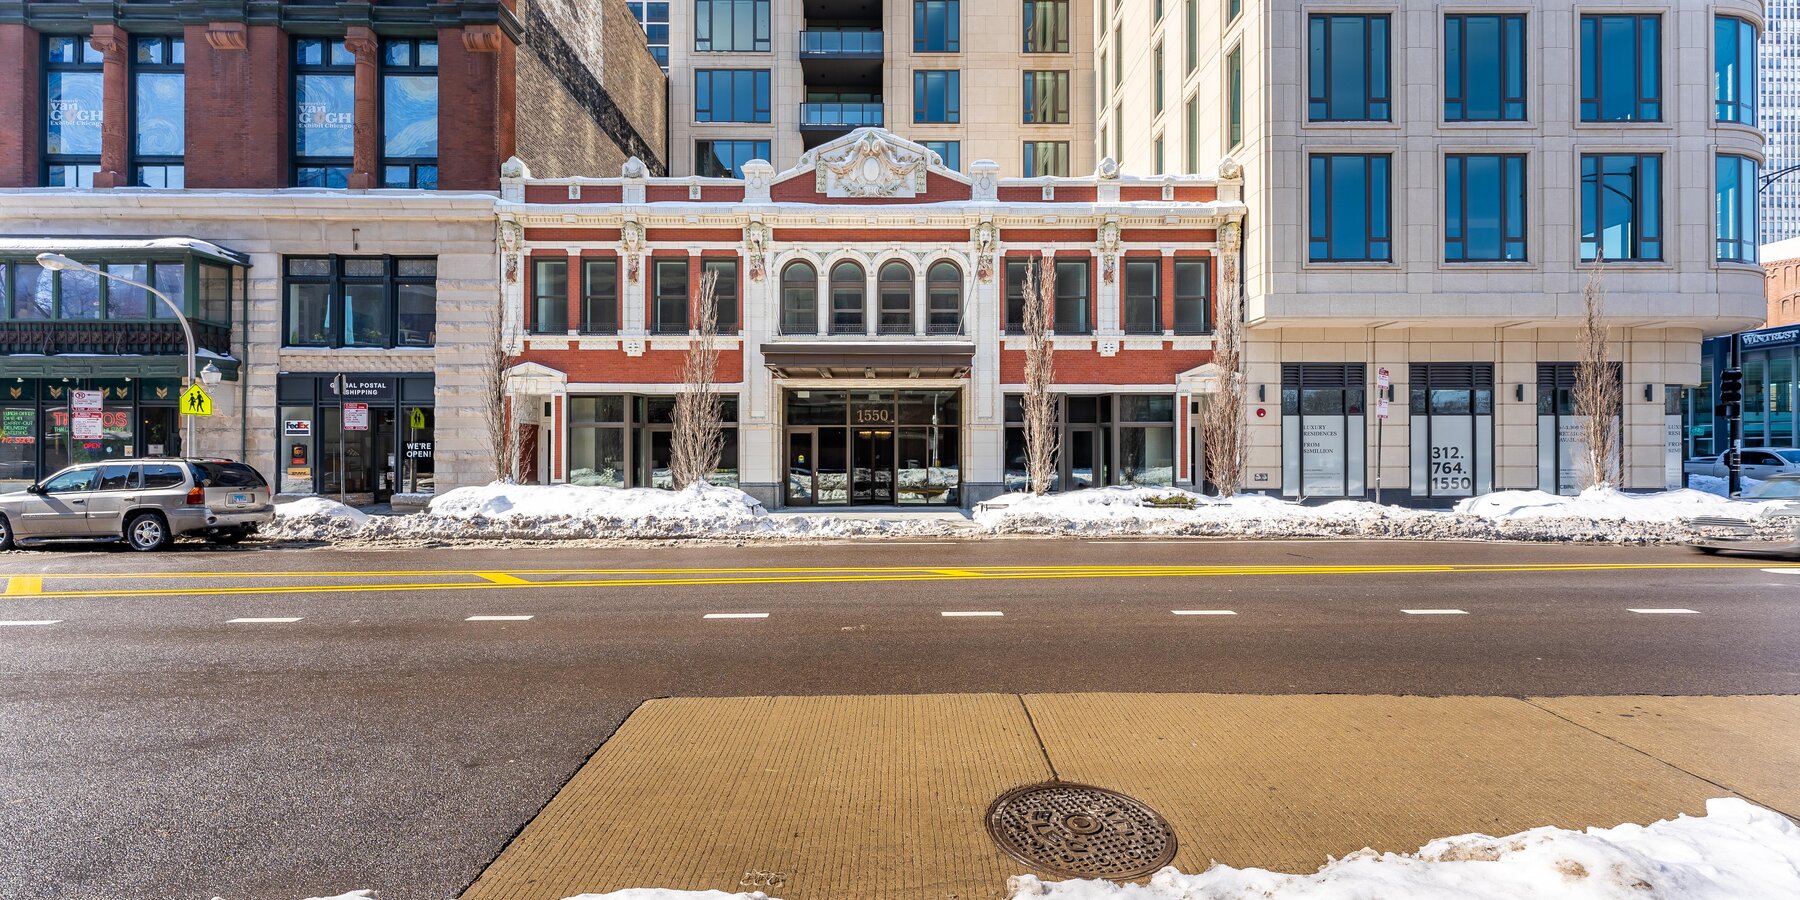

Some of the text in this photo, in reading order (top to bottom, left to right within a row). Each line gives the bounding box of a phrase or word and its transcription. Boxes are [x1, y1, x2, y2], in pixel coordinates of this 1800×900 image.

[299, 105, 326, 113] van
[857, 410, 888, 421] 1550
[1432, 447, 1464, 459] 312.
[1432, 462, 1466, 474] 764.
[1432, 477, 1471, 489] 1550
